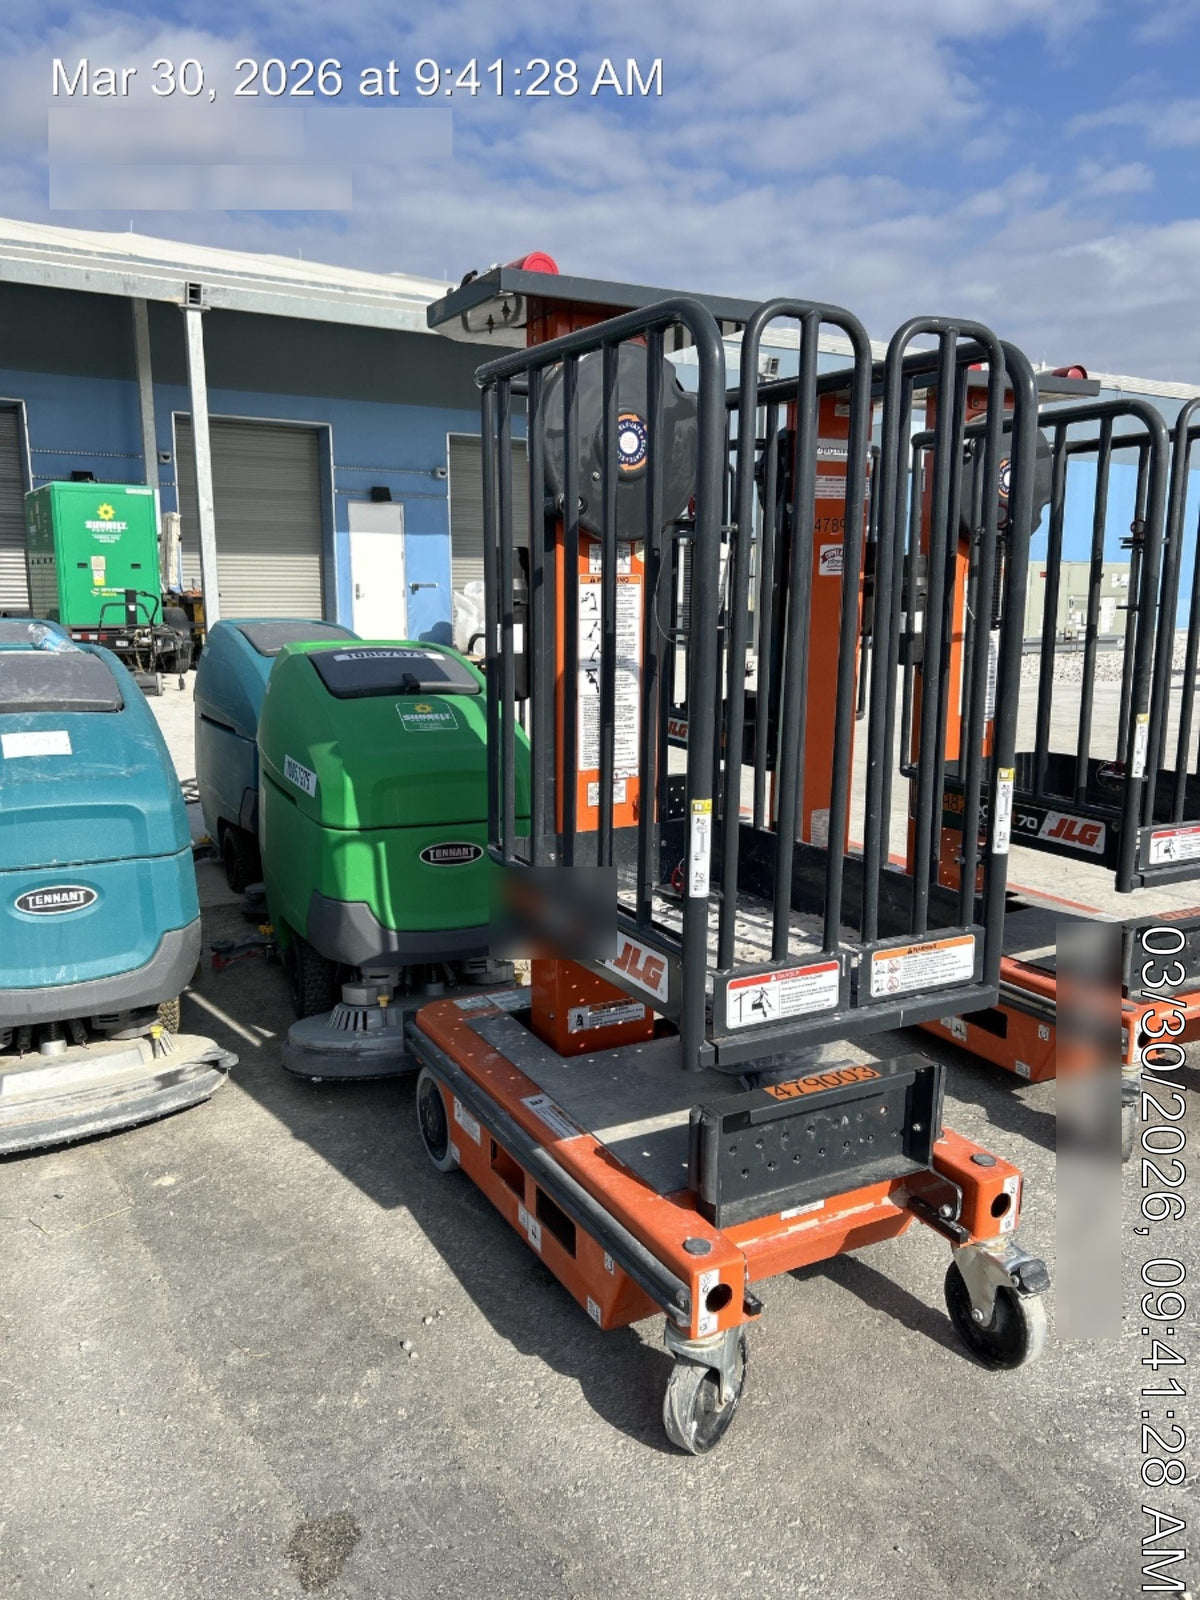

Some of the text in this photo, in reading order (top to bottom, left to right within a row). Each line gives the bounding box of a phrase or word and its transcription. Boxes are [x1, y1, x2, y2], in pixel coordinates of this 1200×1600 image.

[1047, 818, 1103, 848] JLG
[429, 846, 476, 861] TENNANT
[26, 890, 86, 909] TENNANT
[612, 941, 667, 992] JLG
[774, 1066, 877, 1098] 479003
